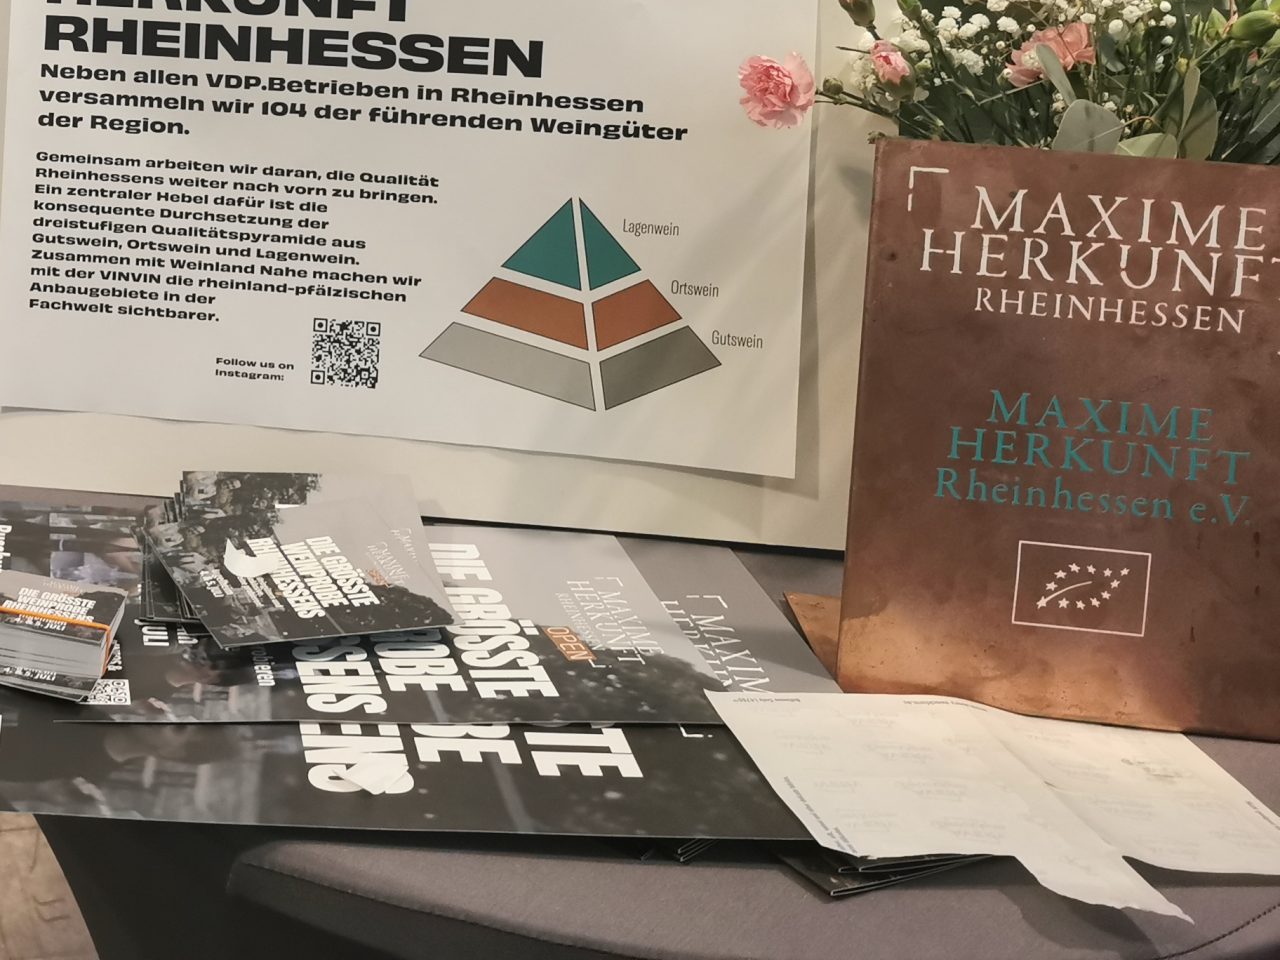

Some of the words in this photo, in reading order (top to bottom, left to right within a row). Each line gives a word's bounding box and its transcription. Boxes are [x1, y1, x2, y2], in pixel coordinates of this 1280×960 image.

[44, 15, 544, 79] RHEINHESSEN
[40, 63, 127, 82] Neben
[133, 68, 199, 87] allen
[205, 72, 409, 100] VDP.Betrieben
[416, 85, 443, 102] in
[450, 87, 644, 113] Rheinhessen
[37, 111, 84, 129] der
[90, 114, 191, 136] Region.
[38, 89, 205, 112] versammeln
[211, 98, 255, 115] wir
[261, 101, 308, 118] 104
[313, 104, 362, 122] der
[368, 107, 523, 132] führenden
[529, 117, 689, 142] Weingüter
[35, 151, 141, 168] Gemeinsam
[145, 158, 225, 173] arbeiten
[229, 163, 259, 175] wir
[262, 165, 322, 181] daran,
[325, 169, 355, 182] die
[359, 172, 440, 188] Qualität
[35, 167, 165, 186] Rheinhessens
[168, 177, 229, 190] weiter
[232, 181, 280, 193] nach
[283, 185, 327, 197] vorn
[331, 188, 355, 199] zu
[359, 188, 438, 205] bringen.
[33, 199, 155, 218] konsequente
[159, 208, 293, 229] Durchsetzung
[297, 217, 330, 230] der
[34, 183, 62, 195] Ein
[66, 187, 153, 201] zentraler
[156, 191, 209, 205] Hebel
[213, 195, 266, 209] dafür
[269, 198, 295, 211] ist
[298, 201, 328, 213] die
[32, 216, 147, 234] dreistufigen
[151, 224, 327, 247] Qualitätspyramide
[331, 238, 367, 250] aus
[622, 218, 680, 238] Lagenwein
[970, 185, 1267, 253] MAXIME
[31, 232, 123, 250] Gutswein,
[126, 239, 211, 255] Ortswein
[215, 246, 252, 258] und
[255, 248, 360, 266] Lagenwein.
[31, 249, 131, 266] Zusammen
[135, 256, 166, 268] mit
[169, 258, 255, 275] Weinland
[260, 265, 308, 279] Nahe
[312, 270, 388, 285] machen
[392, 275, 423, 287] wir
[920, 228, 1280, 299] HERKUNF
[29, 281, 159, 301] Anbaugebiete
[163, 290, 180, 302] in
[184, 292, 217, 305] der
[30, 265, 61, 277] mit
[64, 267, 96, 279] der
[99, 269, 161, 284] VINVIN
[165, 274, 194, 287] die
[198, 277, 407, 303] rheinland-pfälzischen
[670, 279, 720, 298] Ortswein
[28, 298, 114, 314] Fachwelt
[117, 304, 220, 323] sichtbarer.
[974, 288, 1246, 335] RHEINHESSEN
[711, 329, 764, 350] Gutswein
[214, 368, 285, 382] Instagram:
[215, 357, 257, 368] Follow
[259, 361, 276, 369] us
[277, 362, 295, 371] on
[987, 389, 1215, 443] MAXIME
[947, 426, 1251, 486] HERKUNFT
[934, 467, 1174, 519] Rheinhessen
[1189, 493, 1253, 527] e.V.
[305, 536, 341, 556] DIE
[18, 587, 40, 598] DIE
[279, 541, 349, 608] WEINPROBE
[321, 555, 380, 607] GRÖSSTE
[567, 580, 646, 665] HERKUNFT
[444, 587, 560, 699] GRÖSSTE
[546, 627, 594, 661] OPEN
[690, 614, 773, 693] MAXIM
